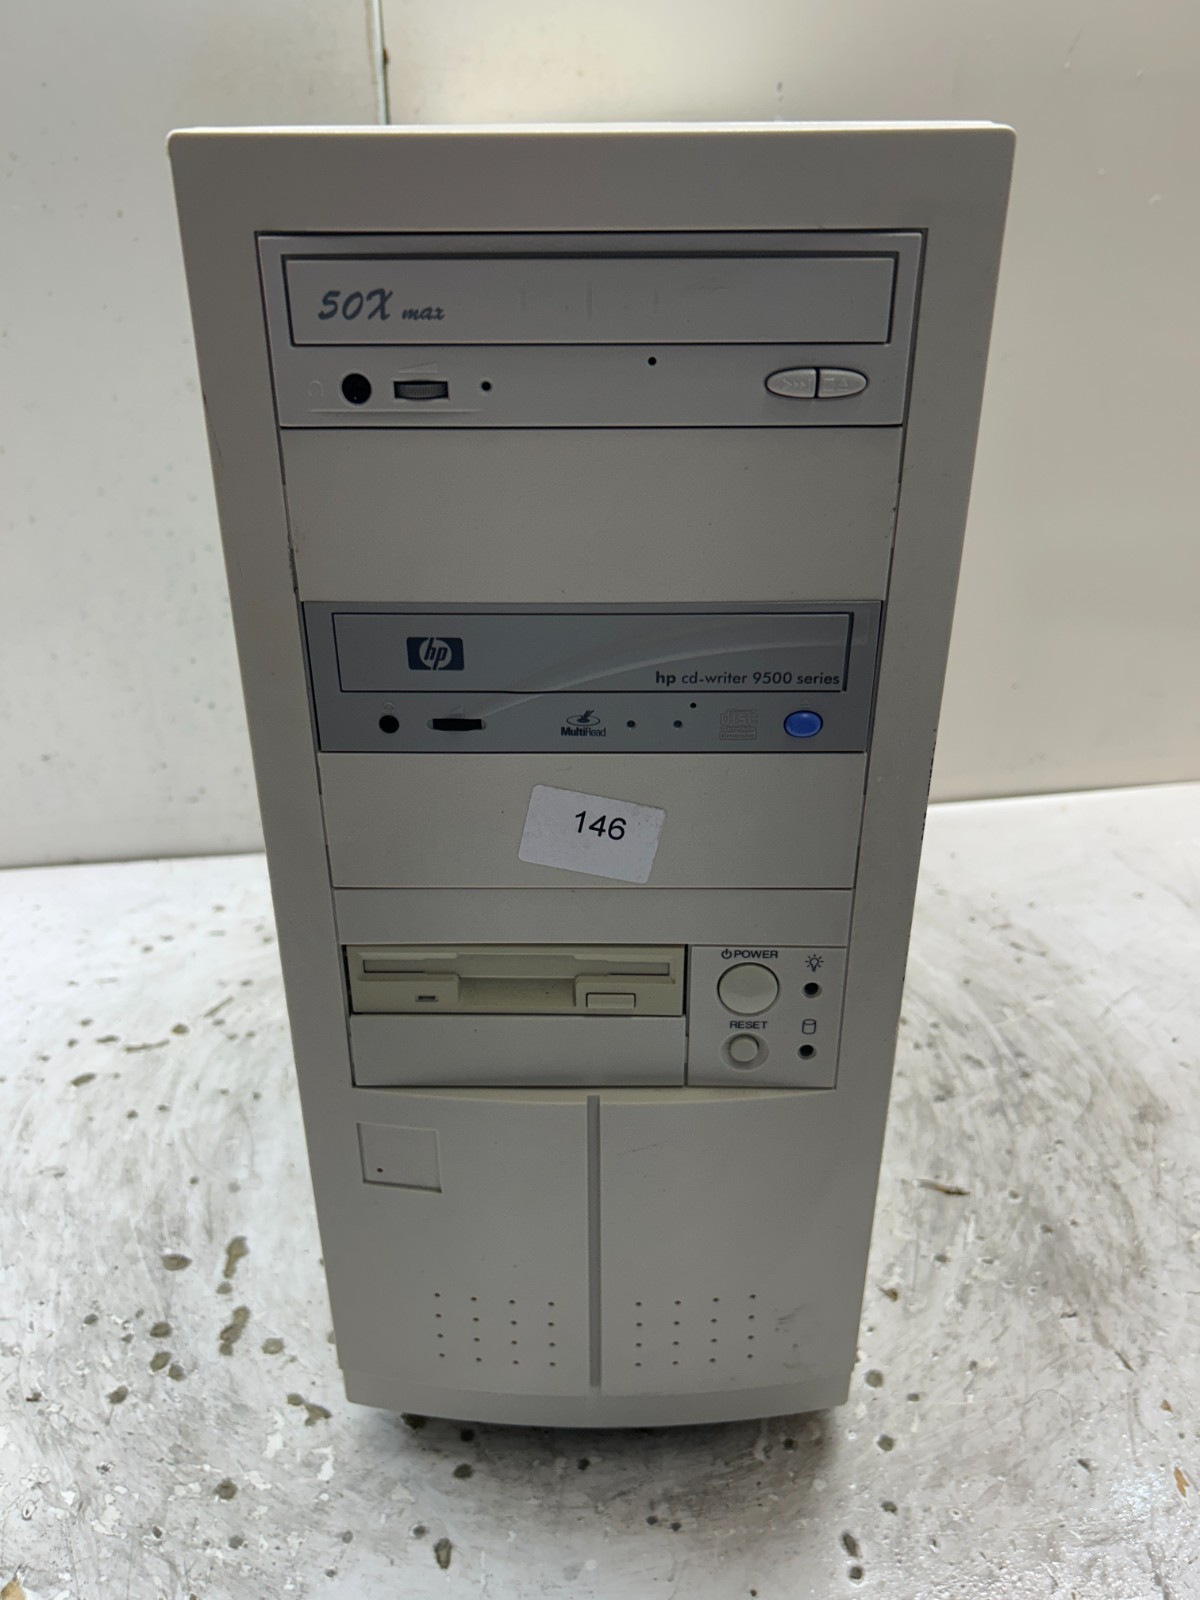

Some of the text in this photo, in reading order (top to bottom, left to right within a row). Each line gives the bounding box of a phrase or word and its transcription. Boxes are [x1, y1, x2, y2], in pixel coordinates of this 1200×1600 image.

[318, 288, 446, 321] 50X max
[424, 637, 449, 670] hp
[655, 671, 840, 687] hp cd-writer 9500 series
[560, 726, 607, 737] MultiRead
[575, 810, 627, 841] 146
[733, 949, 779, 960] POWER
[729, 1020, 768, 1030] RESET
